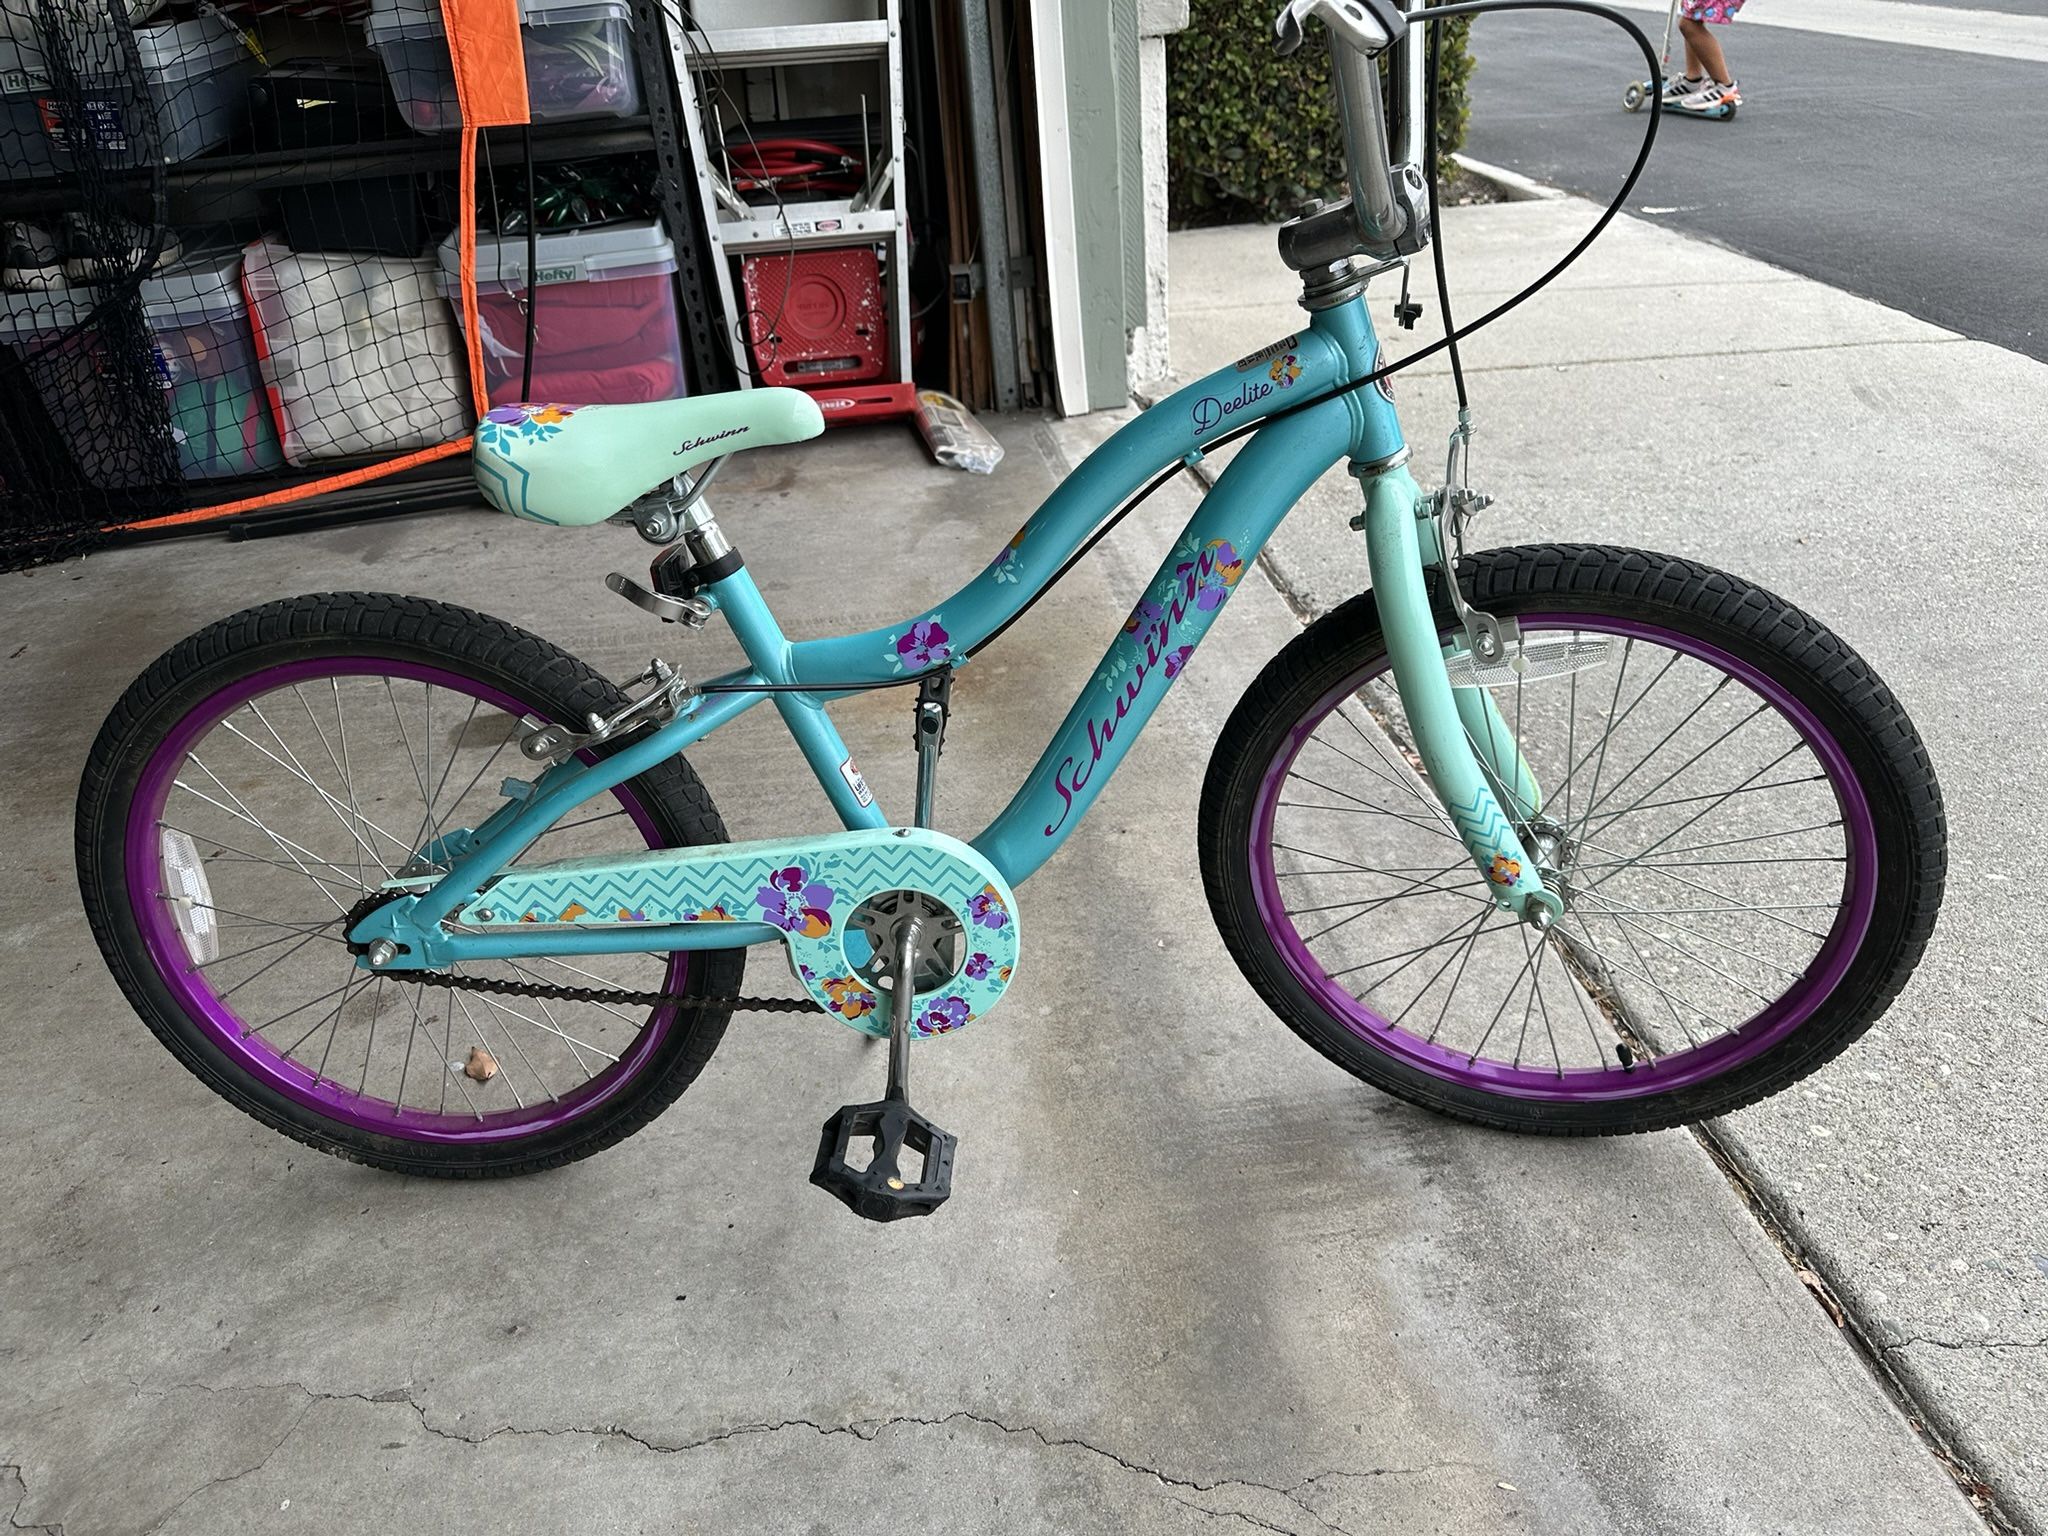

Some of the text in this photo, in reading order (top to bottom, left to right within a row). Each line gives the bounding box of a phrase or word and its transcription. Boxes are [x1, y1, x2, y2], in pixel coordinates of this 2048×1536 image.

[535, 268, 574, 281] Hefty
[1192, 382, 1274, 436] Deelite
[672, 425, 751, 456] Schwinn
[1044, 549, 1217, 837] Schwinn
